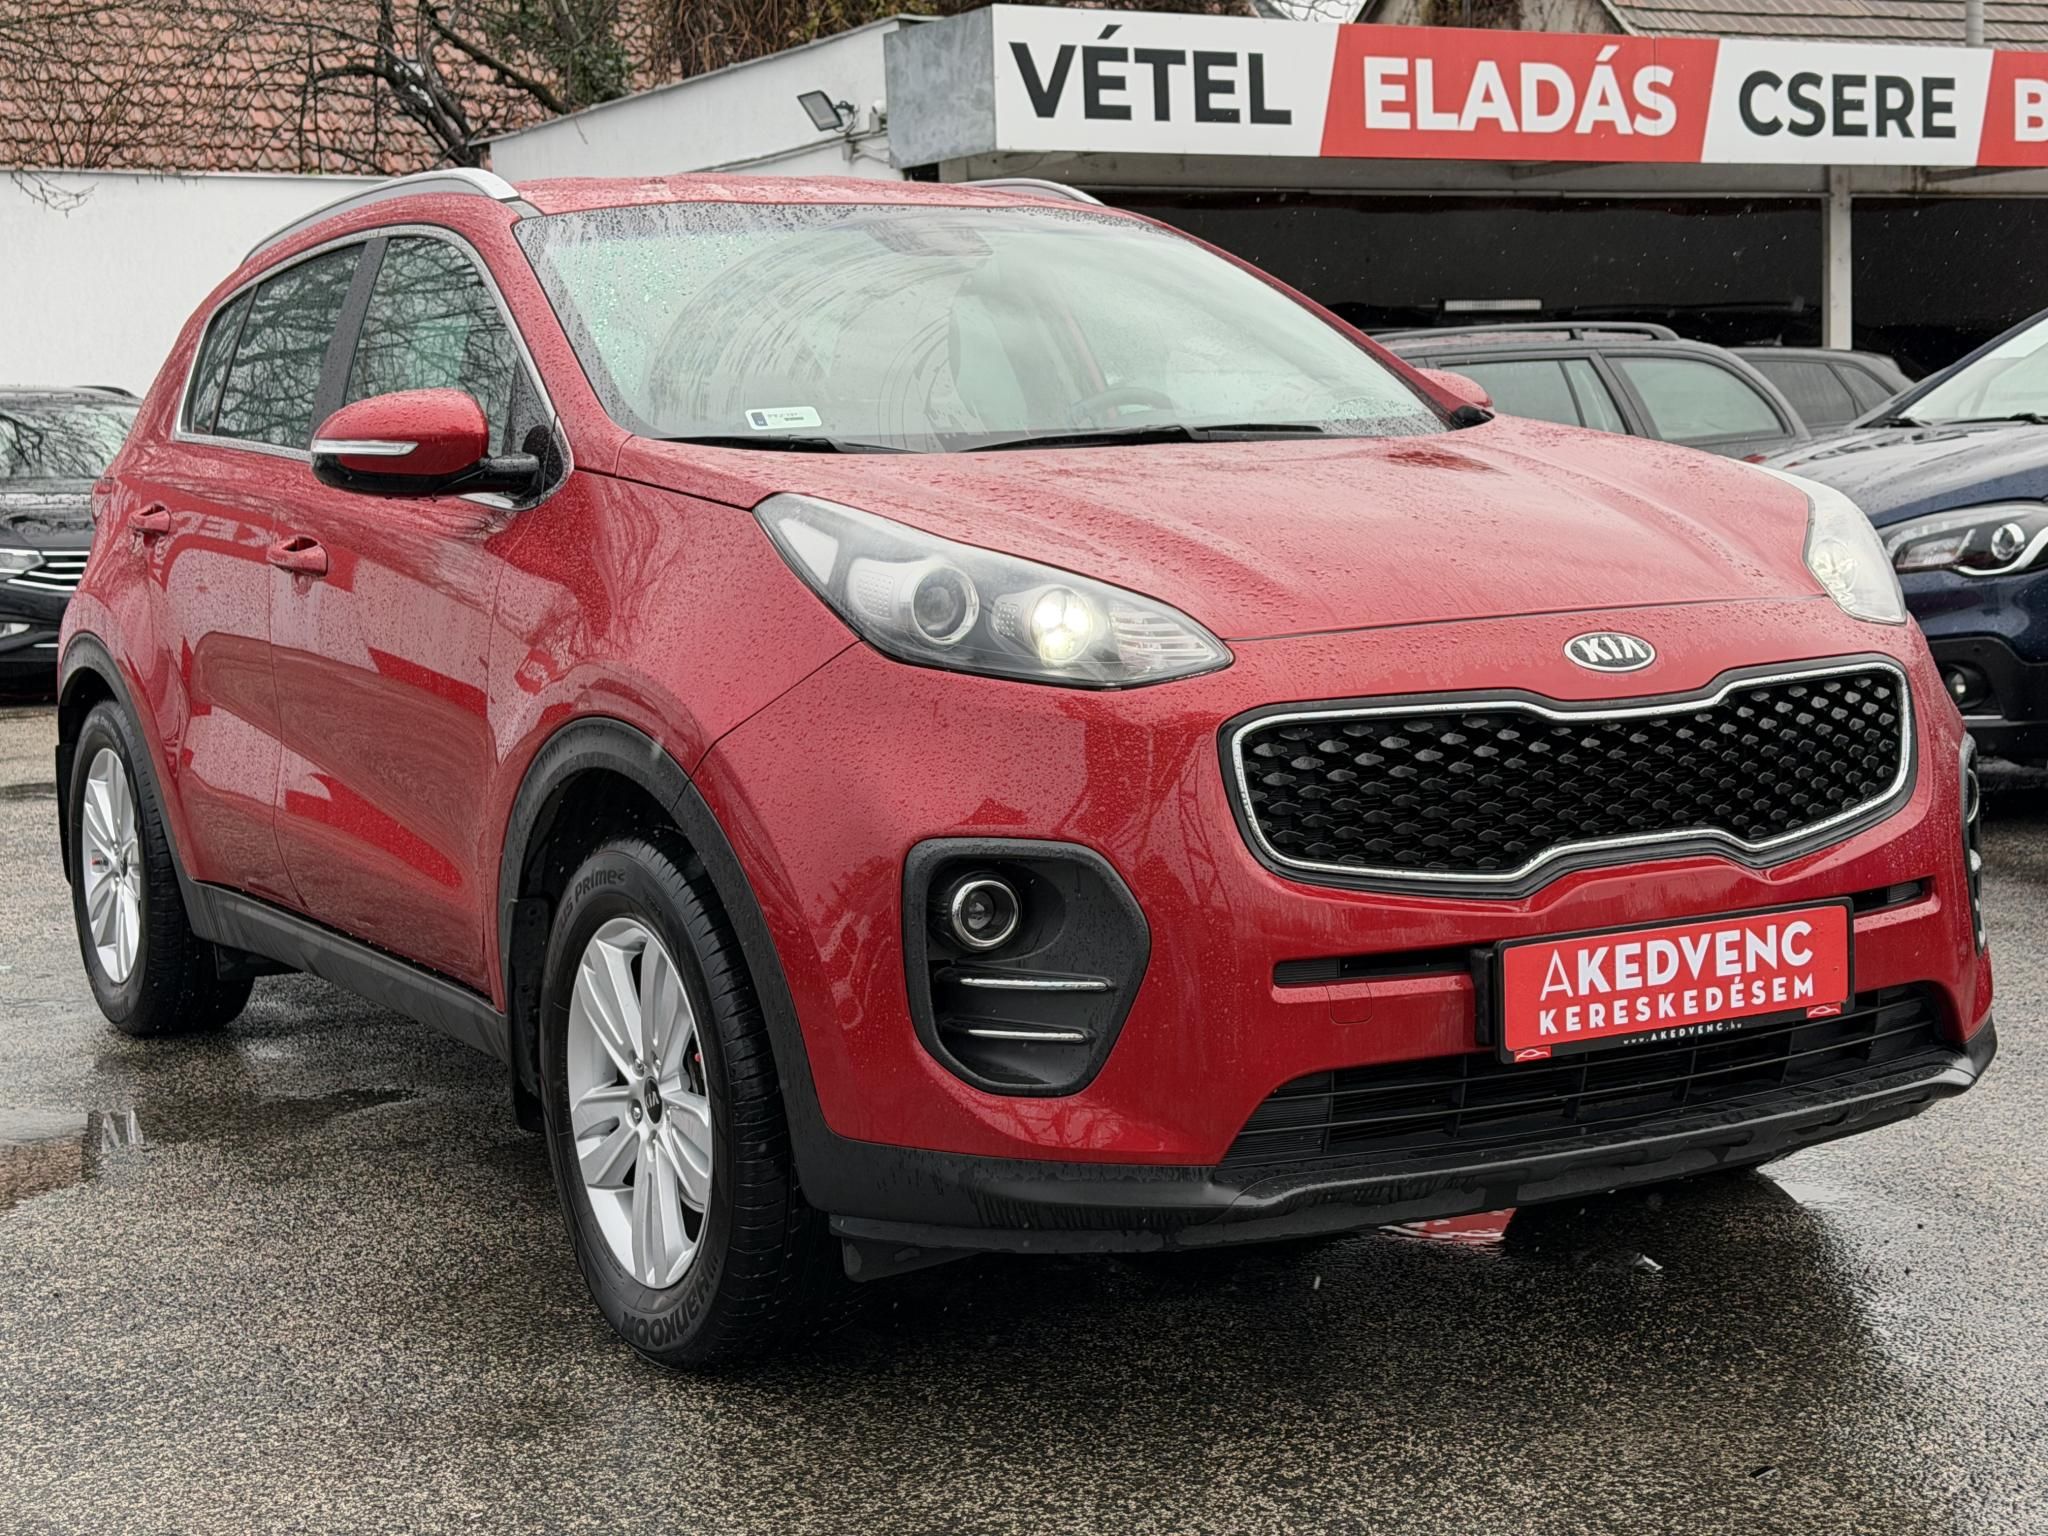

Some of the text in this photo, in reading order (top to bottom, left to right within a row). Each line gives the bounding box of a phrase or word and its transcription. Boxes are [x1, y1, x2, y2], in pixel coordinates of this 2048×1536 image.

[1010, 25, 1291, 124] VÉTEL
[1363, 44, 1678, 136] ELADÁS
[1739, 71, 1956, 138] CSERE
[1575, 635, 1648, 663] KIA
[1539, 919, 1814, 1002] AKEDVENC
[1539, 972, 1815, 1036] KERESKEDÉSEM
